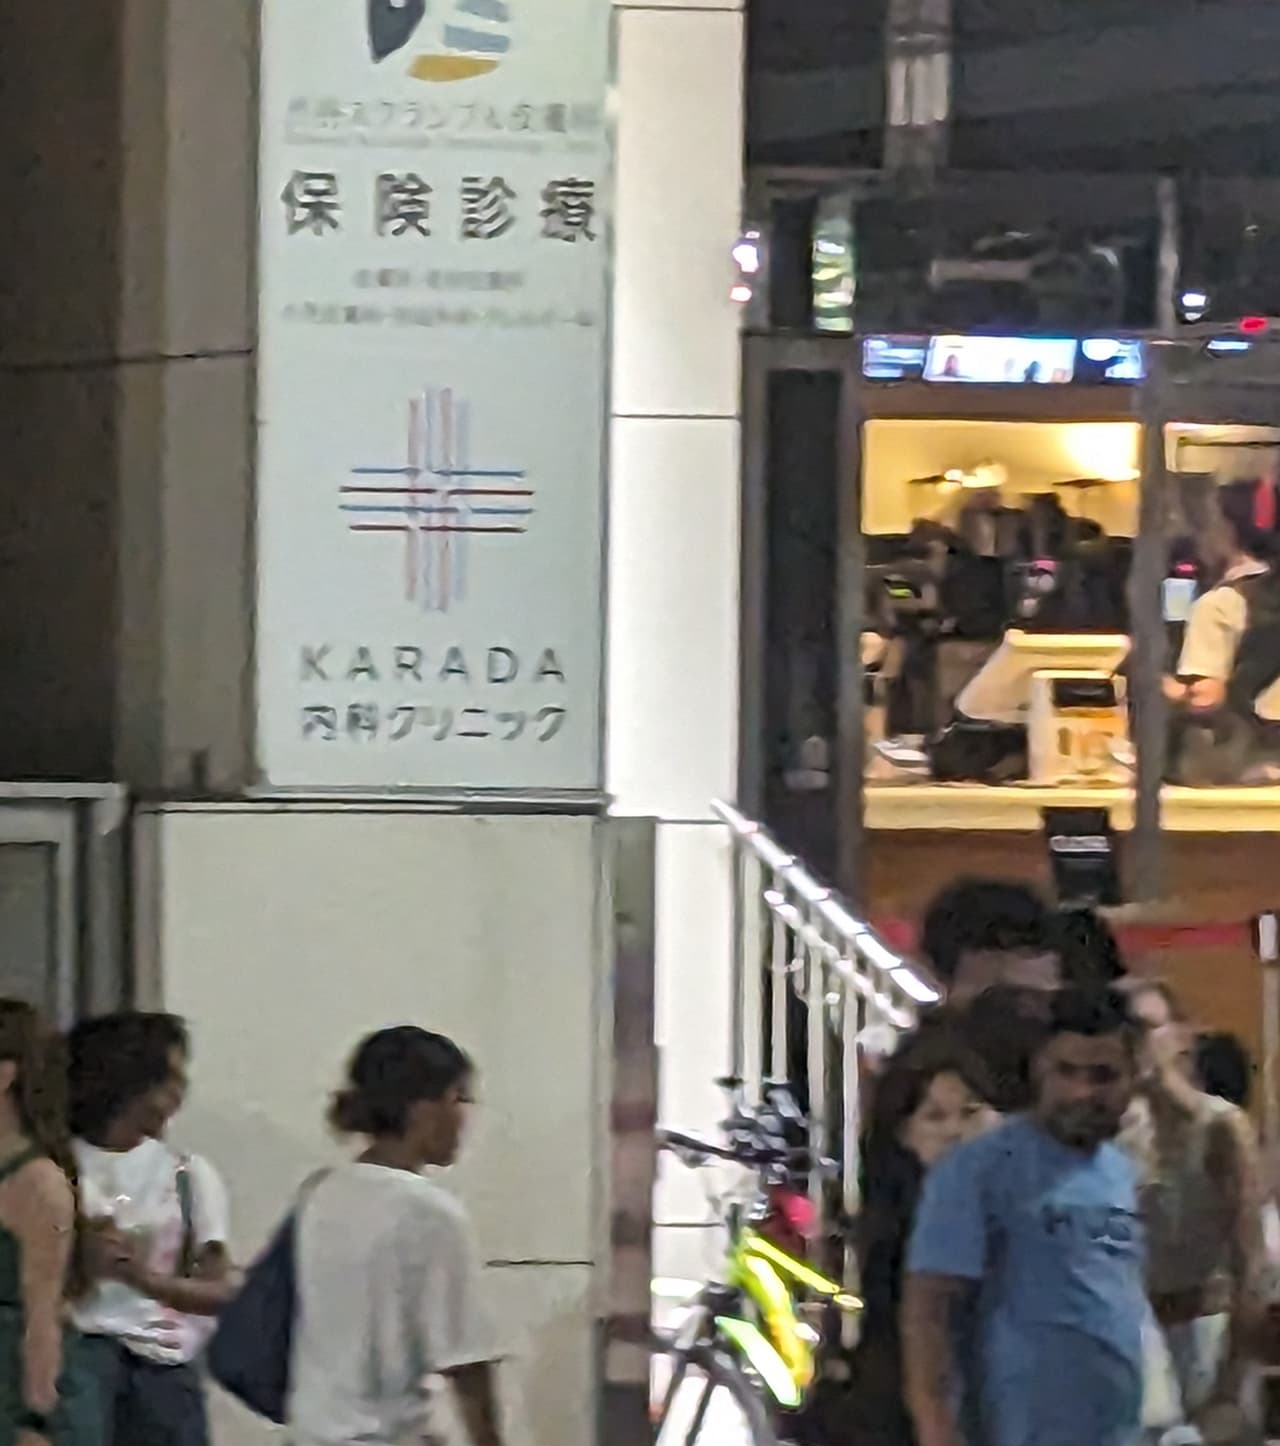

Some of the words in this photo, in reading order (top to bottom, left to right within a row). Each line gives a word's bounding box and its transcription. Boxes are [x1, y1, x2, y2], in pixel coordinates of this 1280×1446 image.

[281, 169, 597, 241] 保険診療
[298, 645, 568, 684] KARADA
[299, 701, 568, 742] 内科クリニック
